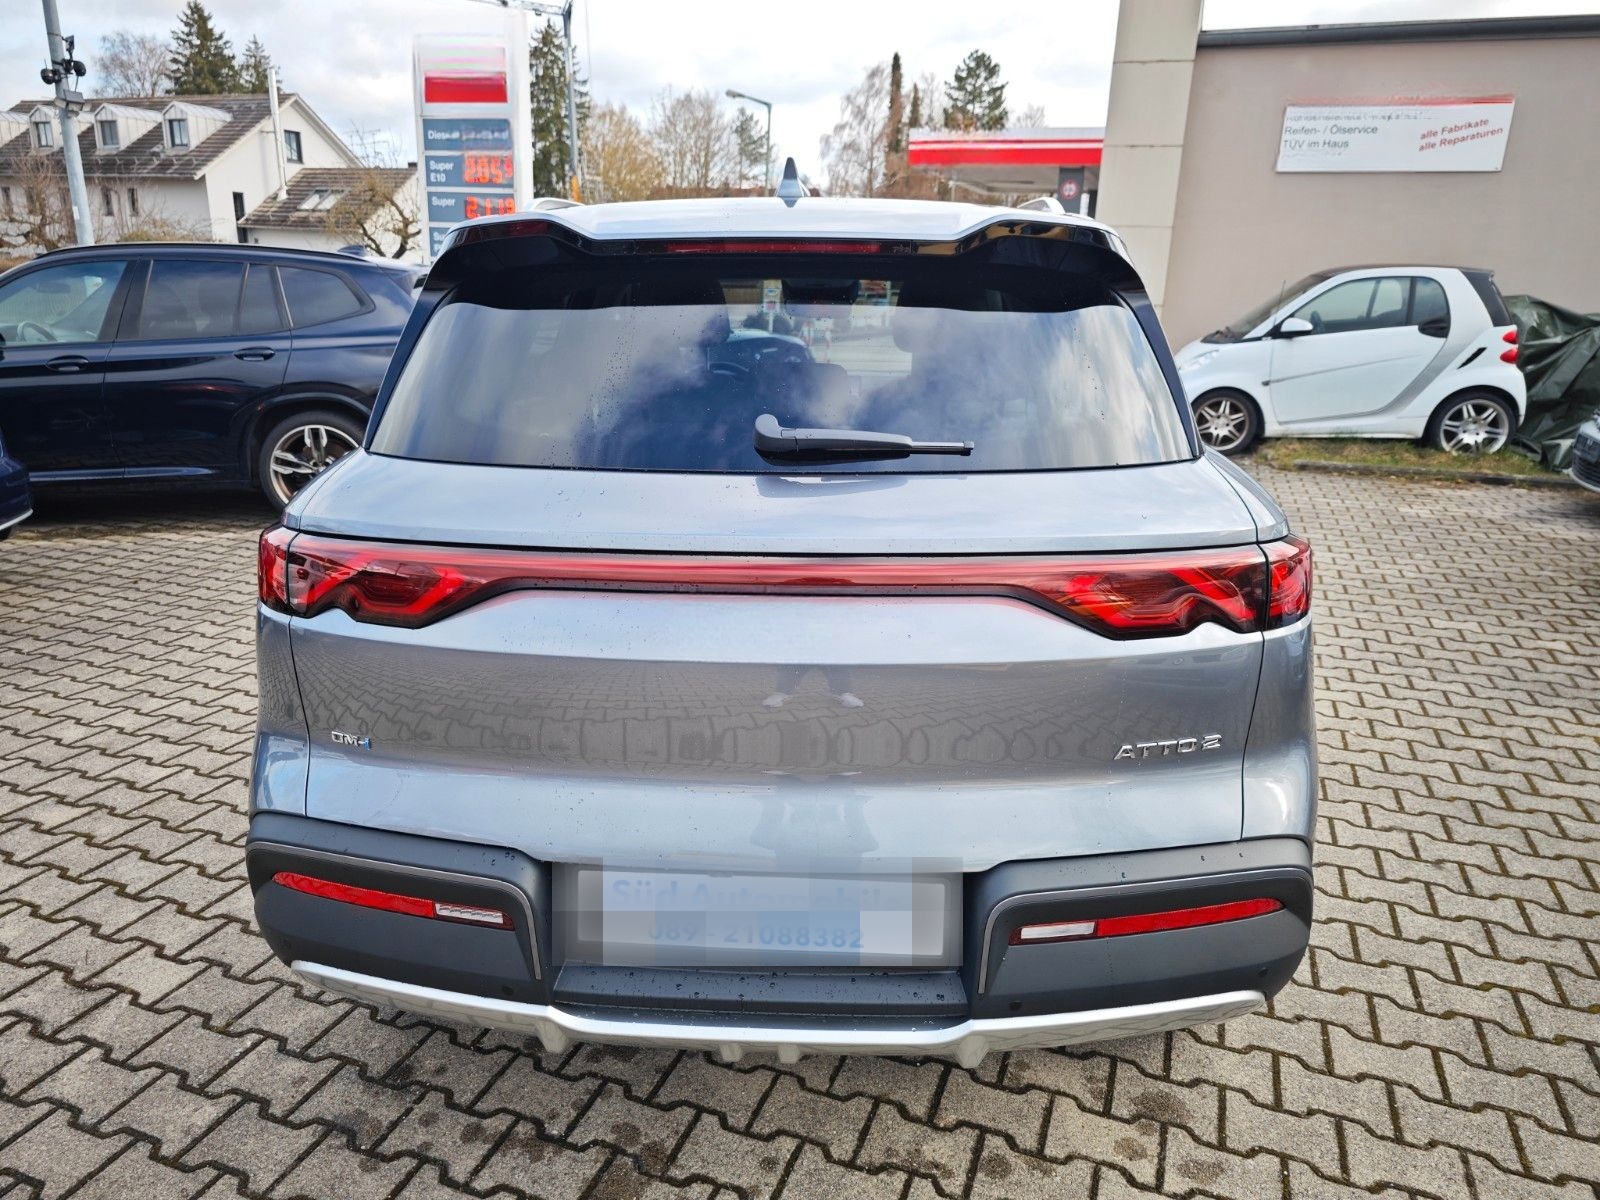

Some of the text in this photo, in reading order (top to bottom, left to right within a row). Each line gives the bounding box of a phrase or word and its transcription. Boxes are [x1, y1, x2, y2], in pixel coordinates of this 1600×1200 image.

[1420, 119, 1489, 140] alle Fabrikate
[1308, 140, 1320, 148] im
[1322, 139, 1350, 148] Haus
[1418, 127, 1504, 152] alle Reparaturen
[429, 160, 454, 171] Super
[430, 173, 446, 182] E10
[432, 196, 456, 208] Super
[1113, 733, 1222, 760] ATTO 2
[648, 920, 699, 941] 089
